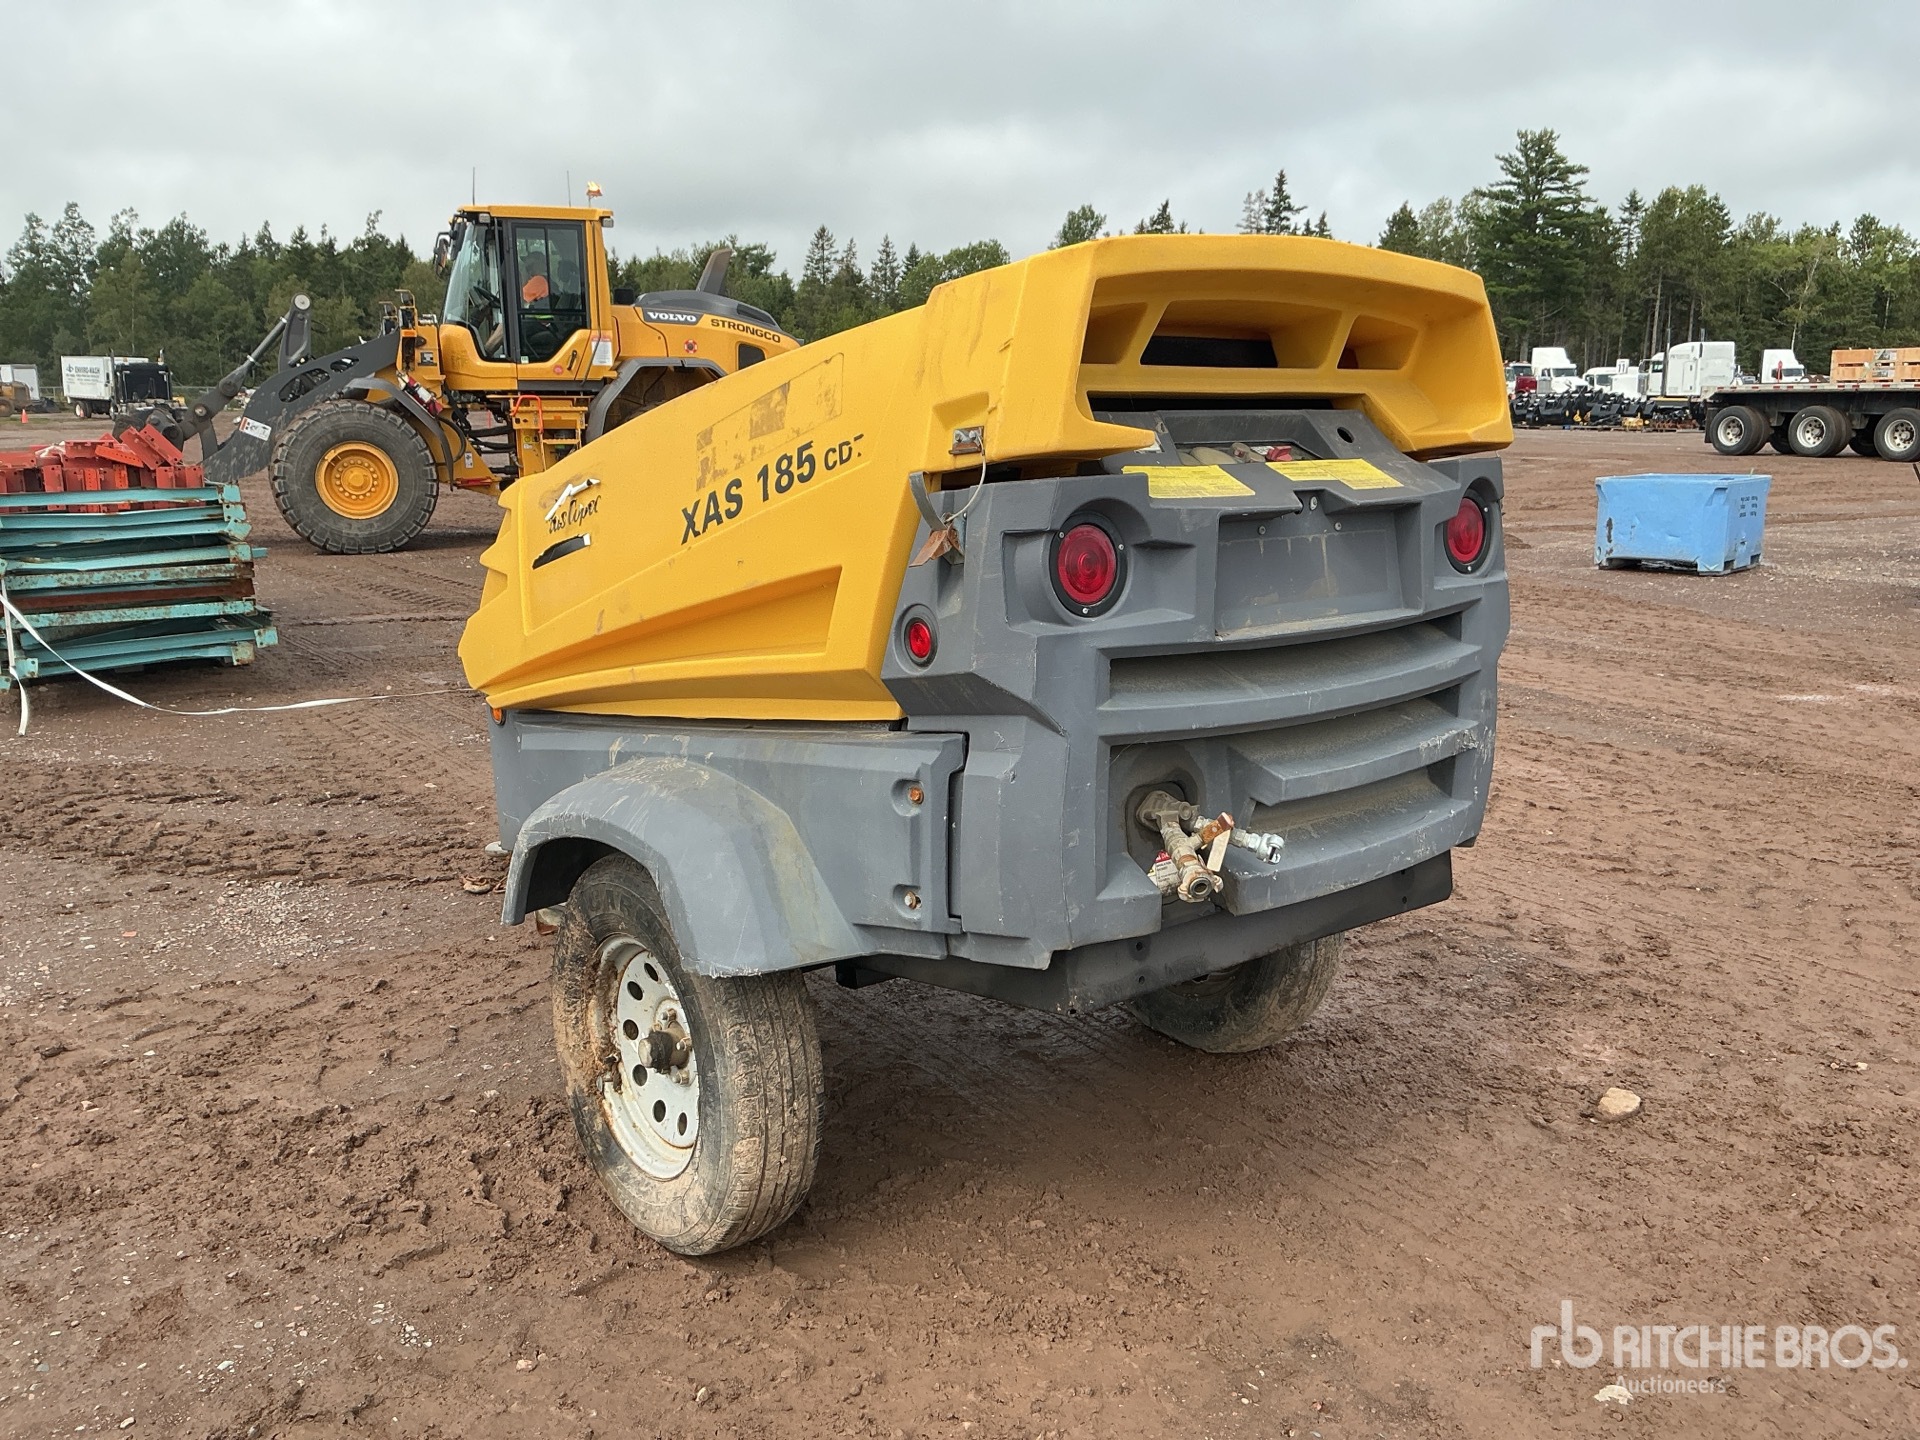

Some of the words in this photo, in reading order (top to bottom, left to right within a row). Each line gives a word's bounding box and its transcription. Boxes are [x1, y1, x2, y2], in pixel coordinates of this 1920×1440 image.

[647, 312, 697, 322] VOLVO
[710, 318, 781, 343] STRONGCO
[680, 478, 743, 546] XAS
[757, 440, 816, 503] 185
